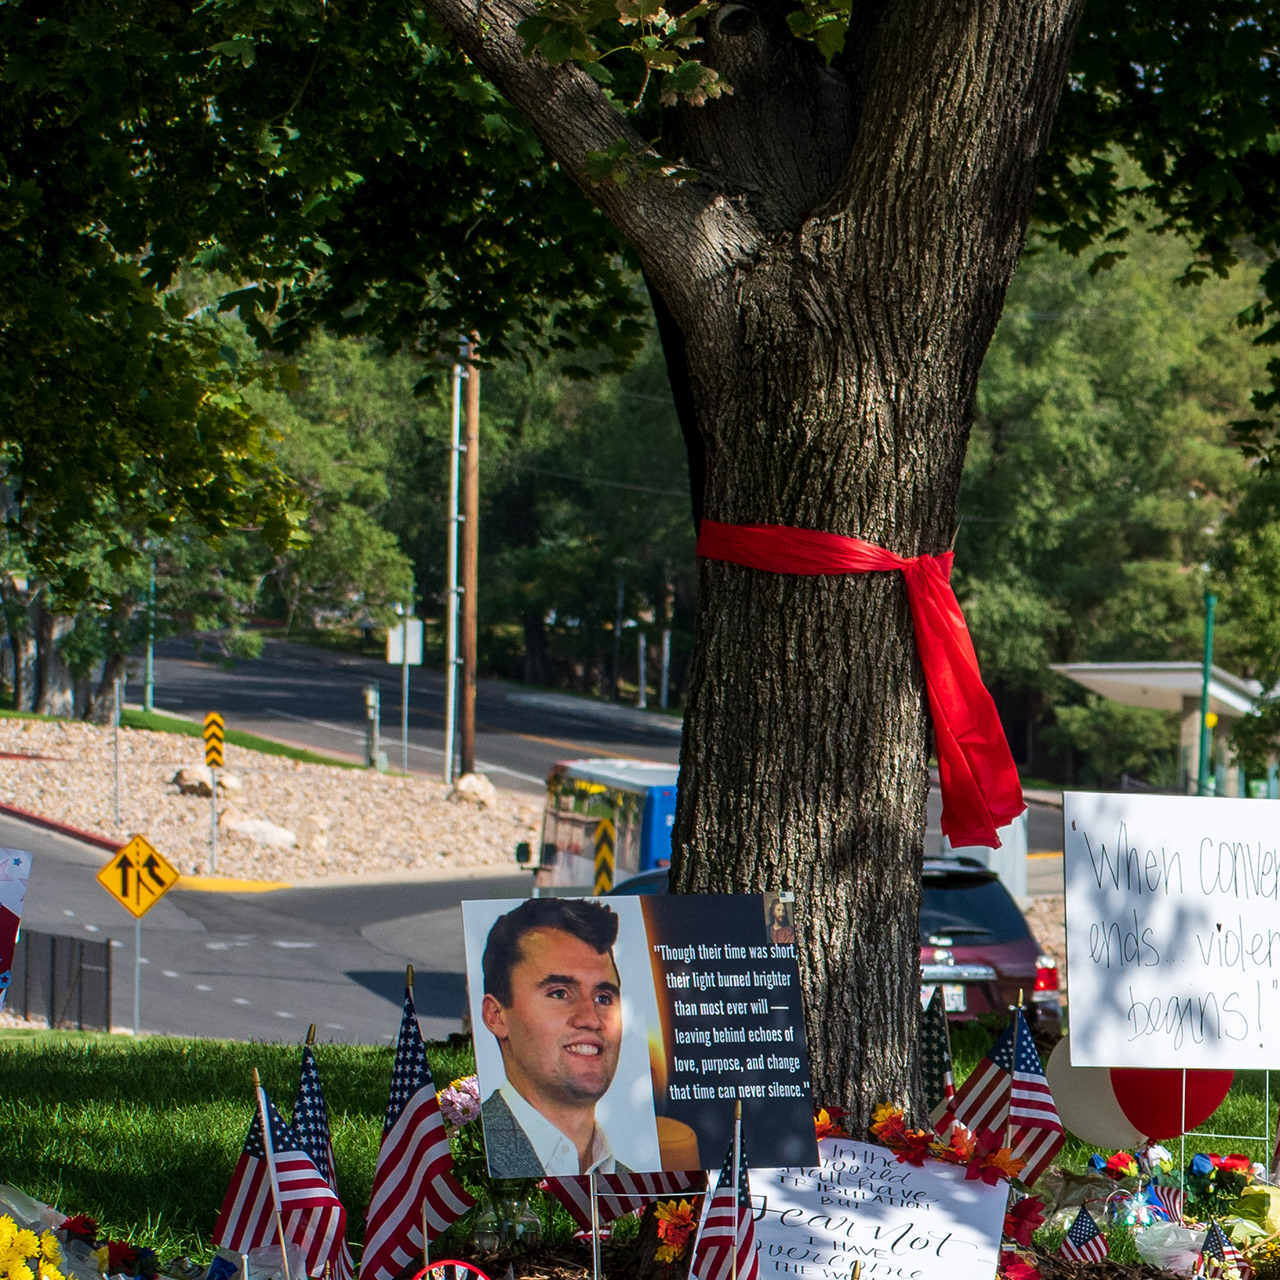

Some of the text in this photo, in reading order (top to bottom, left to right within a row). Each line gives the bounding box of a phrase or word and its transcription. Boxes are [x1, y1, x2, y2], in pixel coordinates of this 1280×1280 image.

[653, 943, 800, 963] "Though their time was short,
[666, 970, 791, 991] their light burned brighter
[674, 1000, 697, 1016] than
[700, 1000, 724, 1016] most
[726, 1001, 748, 1015] ever
[750, 998, 769, 1014] will
[674, 1026, 794, 1047] leaving behind echoes of
[674, 1053, 800, 1075] love, purpose, and change
[669, 1081, 810, 1100] that time can never silence."
[832, 1144, 899, 1170] In the
[823, 1158, 912, 1186] world
[846, 1177, 940, 1202] have
[821, 1196, 874, 1209] BUT
[802, 1235, 888, 1260] I HAVE
[771, 1260, 814, 1275] THE
